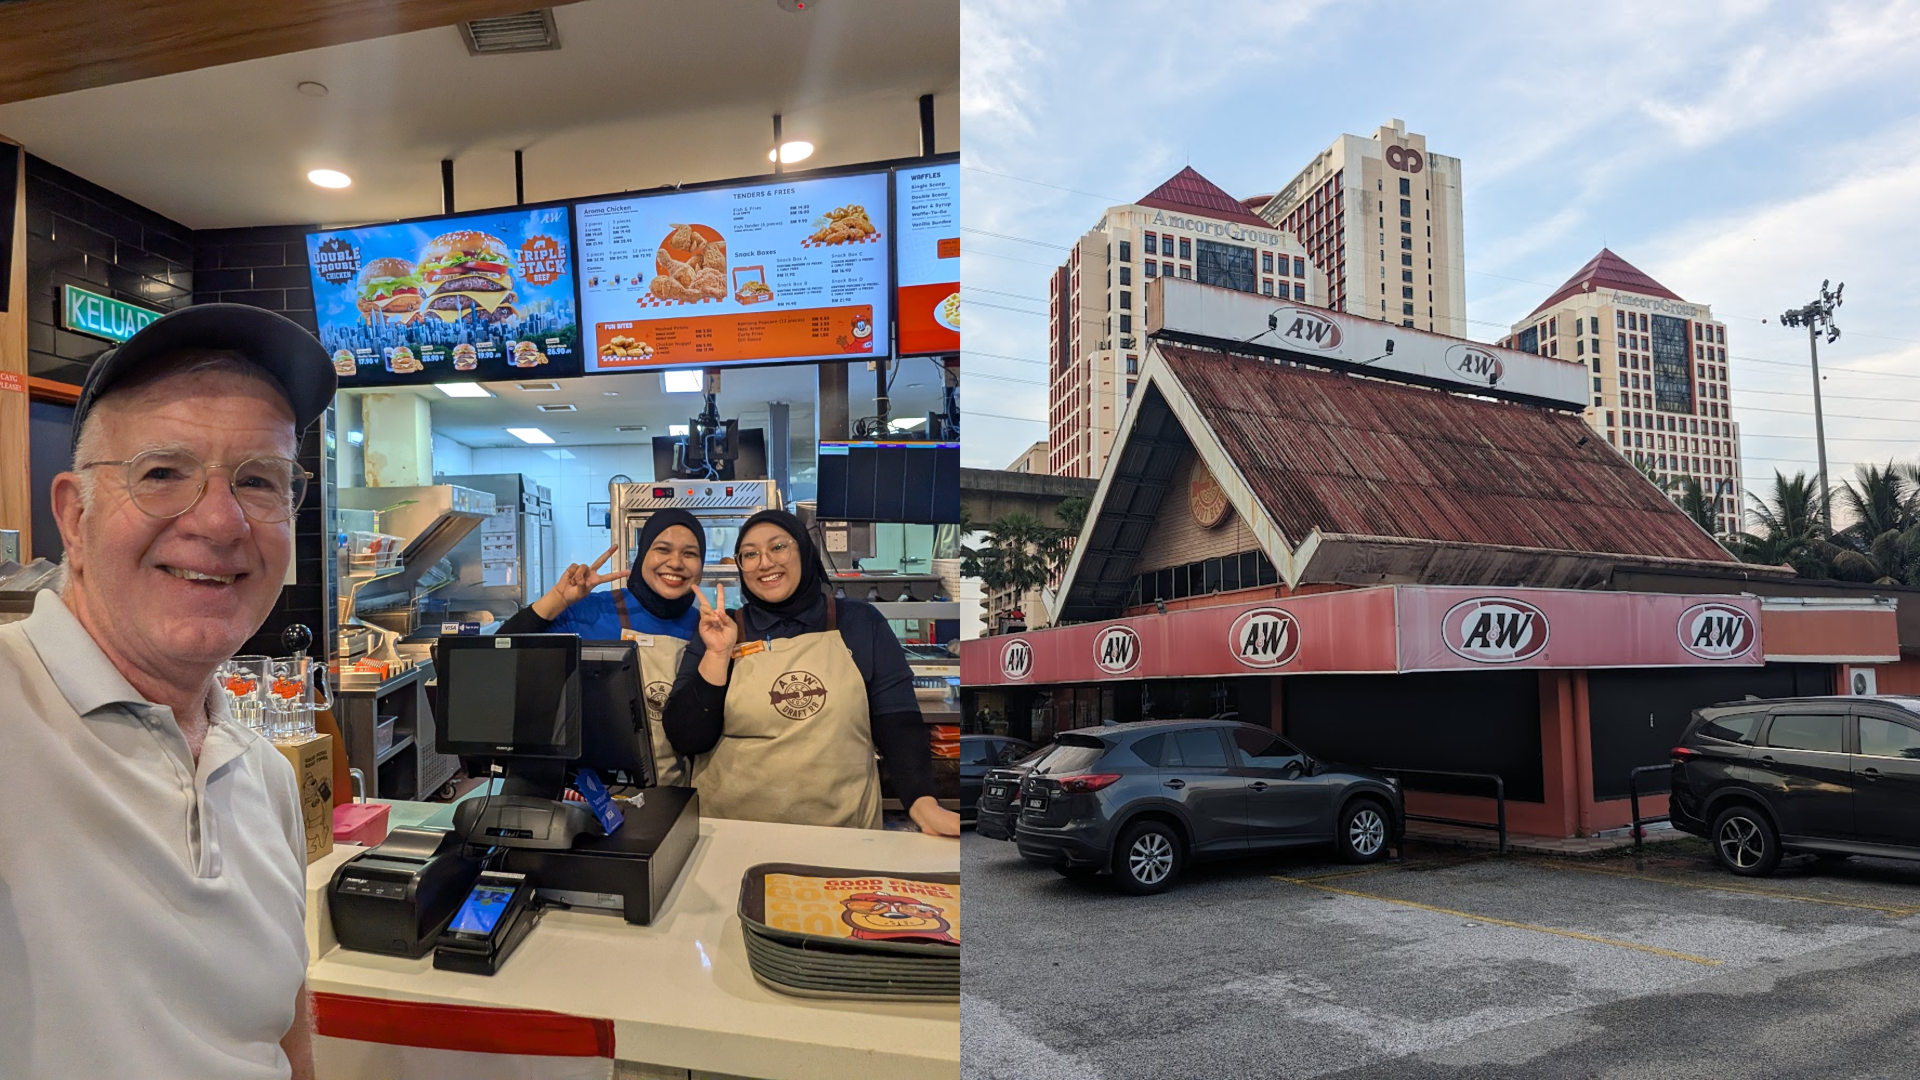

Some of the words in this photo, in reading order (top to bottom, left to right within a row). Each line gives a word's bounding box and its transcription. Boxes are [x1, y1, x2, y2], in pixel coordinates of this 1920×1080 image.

[911, 172, 941, 181] WAFFLES
[733, 191, 765, 200] TENDERS
[606, 205, 632, 213] Chicken
[1153, 209, 1279, 247] AmcorpGroup
[314, 247, 361, 263] DOUBLE
[515, 244, 566, 262] TRIPLE
[315, 260, 362, 276] TROUBLE
[326, 272, 351, 280] CHICKEN
[517, 259, 567, 277] STACK
[534, 274, 550, 282] BEEF
[1612, 290, 1697, 317] AmcorpGroup
[1240, 618, 1290, 658] A&W
[1459, 612, 1536, 650] A&W
[1690, 616, 1745, 649] A&W
[1101, 633, 1134, 665] A&W
[1006, 646, 1029, 672] A&W
[649, 687, 657, 696] A
[779, 680, 788, 689] A
[782, 705, 807, 717] DRAFT
[808, 702, 820, 713] RB
[826, 879, 883, 887] GOOD
[889, 881, 946, 892] FOOD
[890, 885, 953, 900] TIMES
